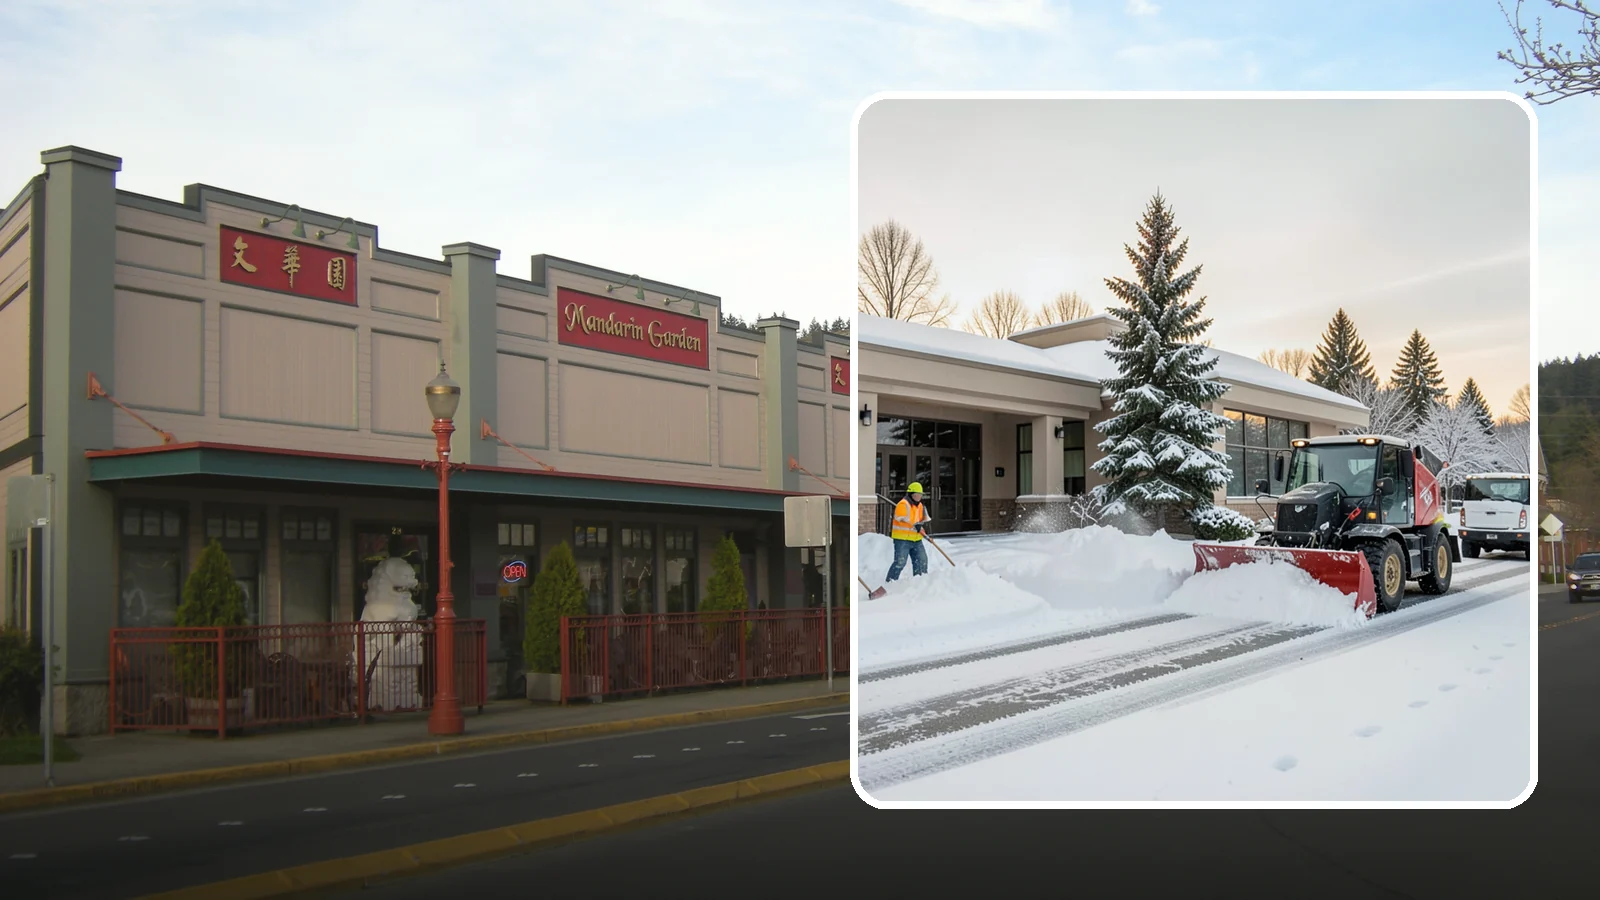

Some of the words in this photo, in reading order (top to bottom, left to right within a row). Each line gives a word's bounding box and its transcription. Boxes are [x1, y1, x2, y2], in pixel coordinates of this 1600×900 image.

[231, 236, 346, 290] 文華園
[564, 302, 644, 341] Mandarin
[647, 320, 702, 352] Garden
[503, 565, 527, 578] OPEN
